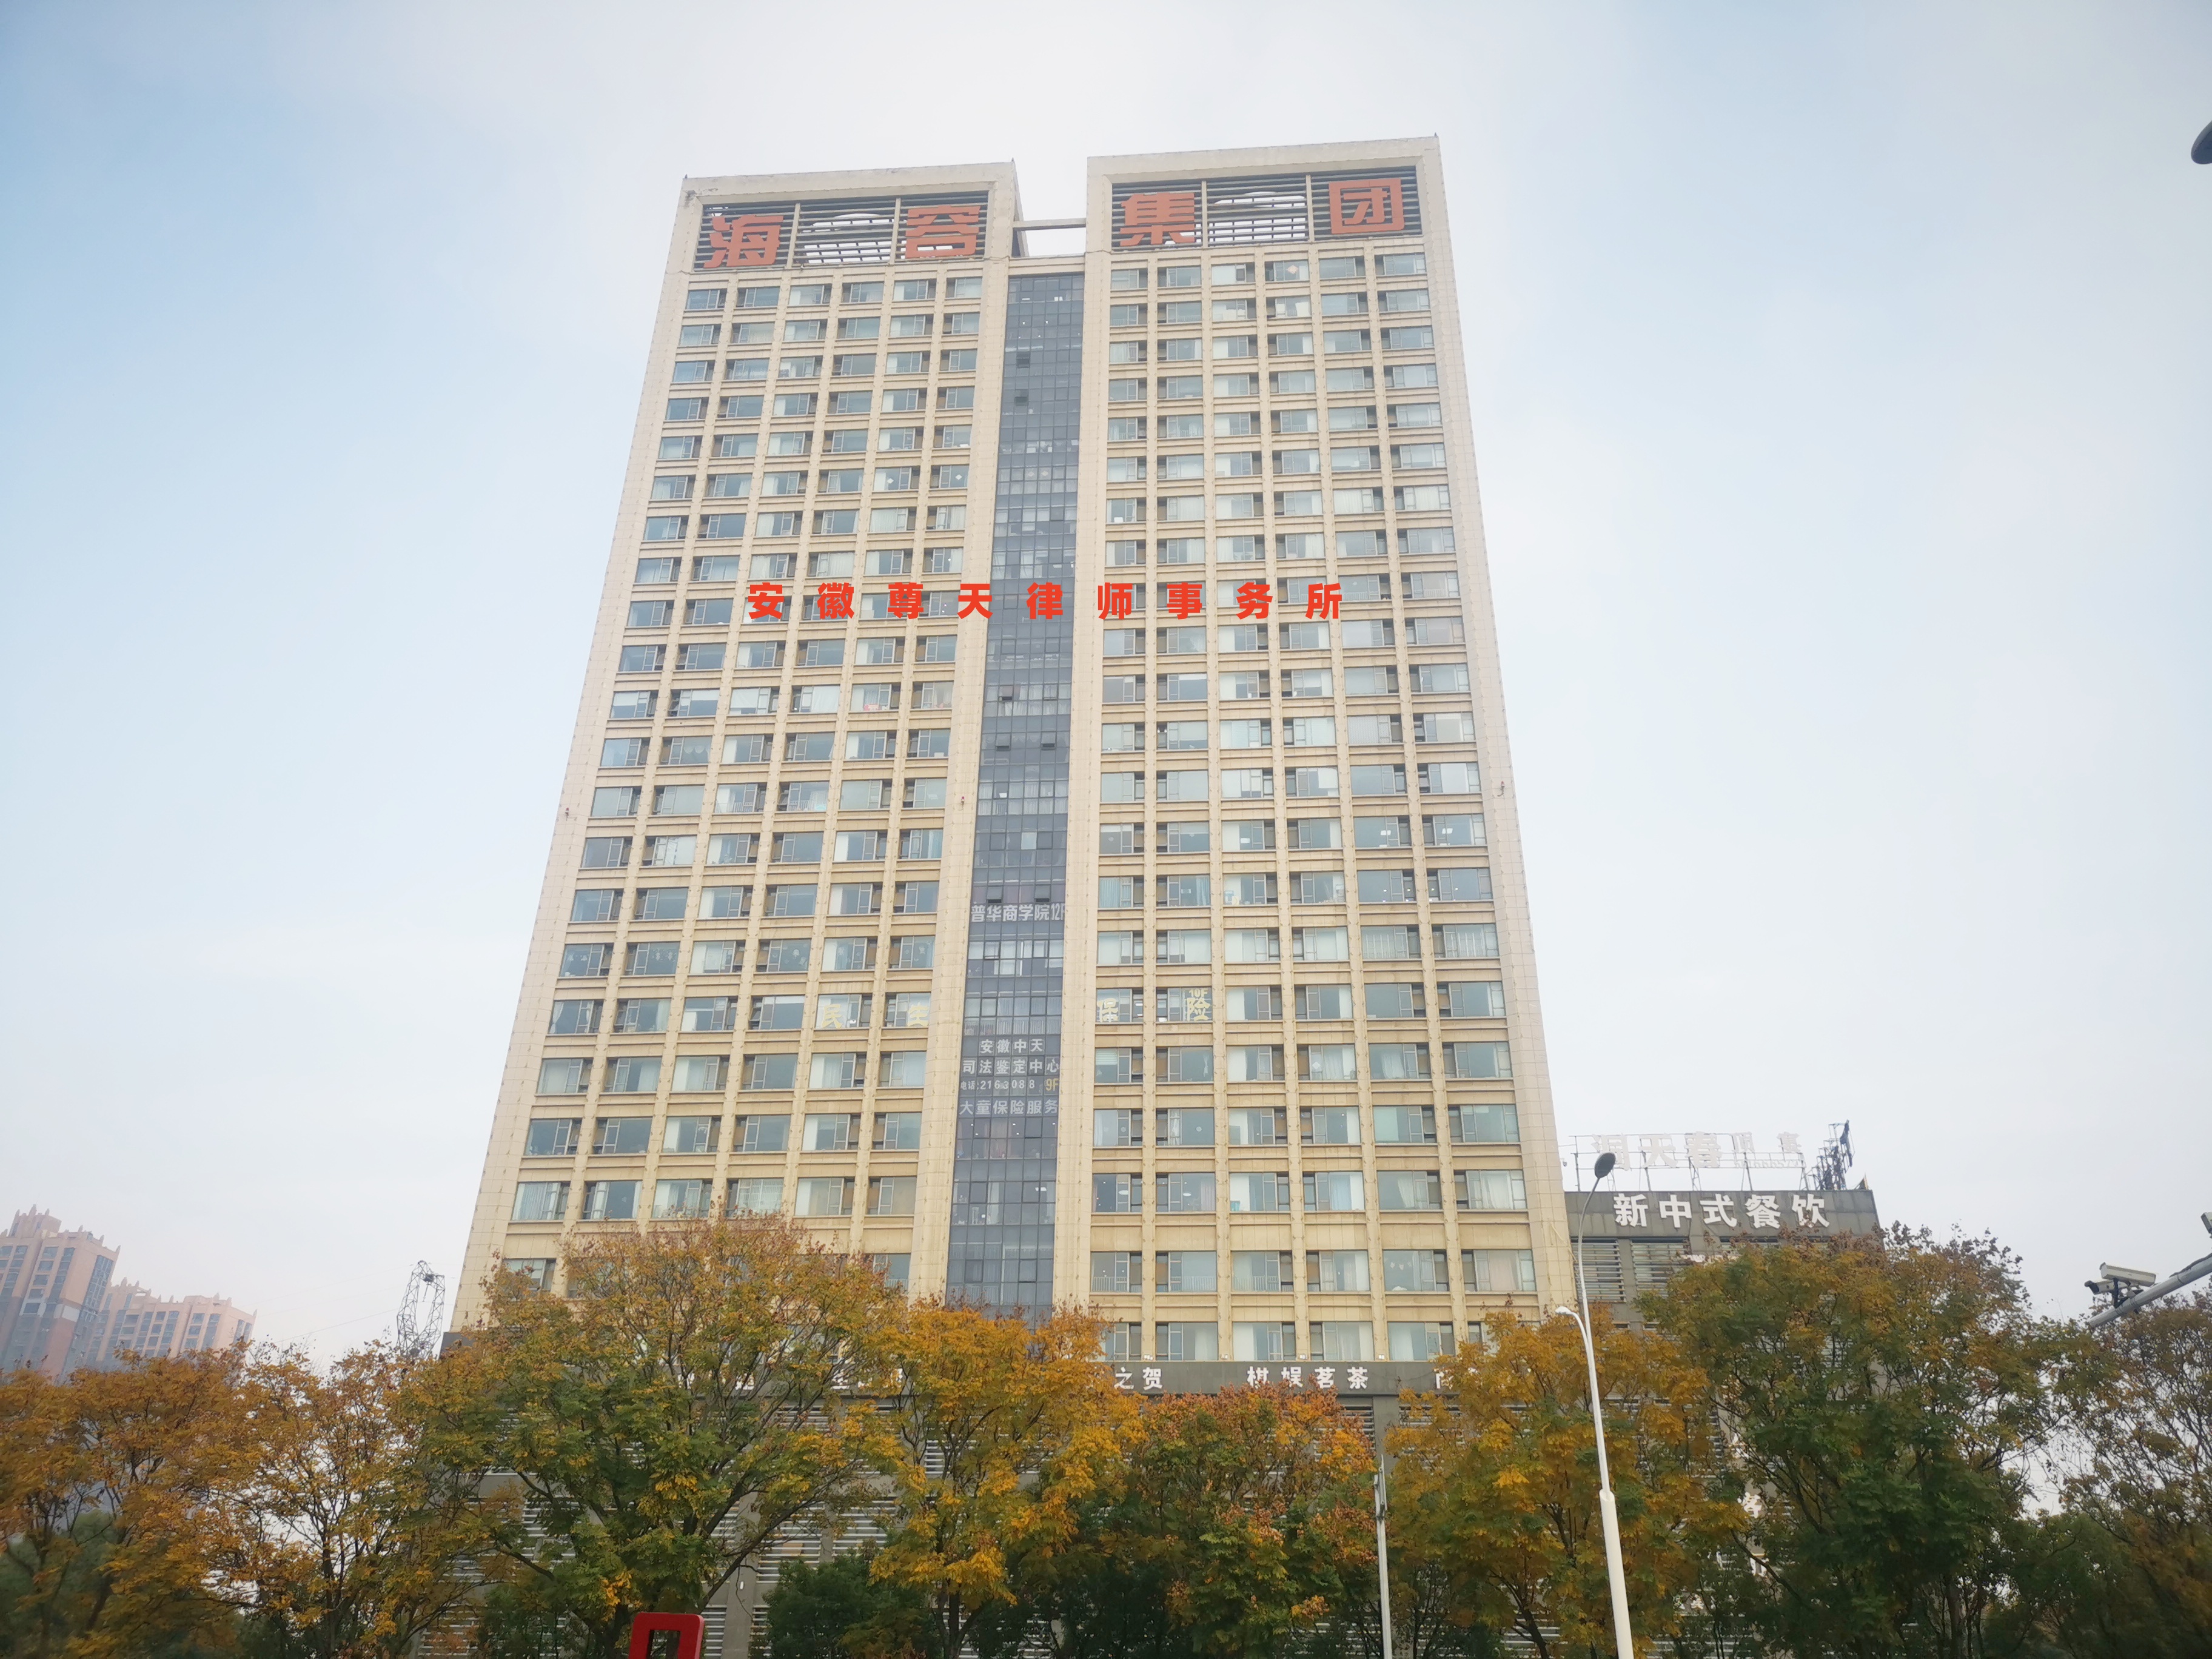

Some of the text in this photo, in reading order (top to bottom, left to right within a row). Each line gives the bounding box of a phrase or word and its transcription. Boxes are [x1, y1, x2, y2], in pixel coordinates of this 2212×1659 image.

[980, 1039, 1044, 1054] 安徽中天
[962, 1059, 1059, 1074] 司法鉴定中心
[959, 1099, 1058, 1116] 大童保险服务
[1614, 1193, 1829, 1228] 新中式餐饮
[1247, 1366, 1369, 1390] 棋娱茗茶
